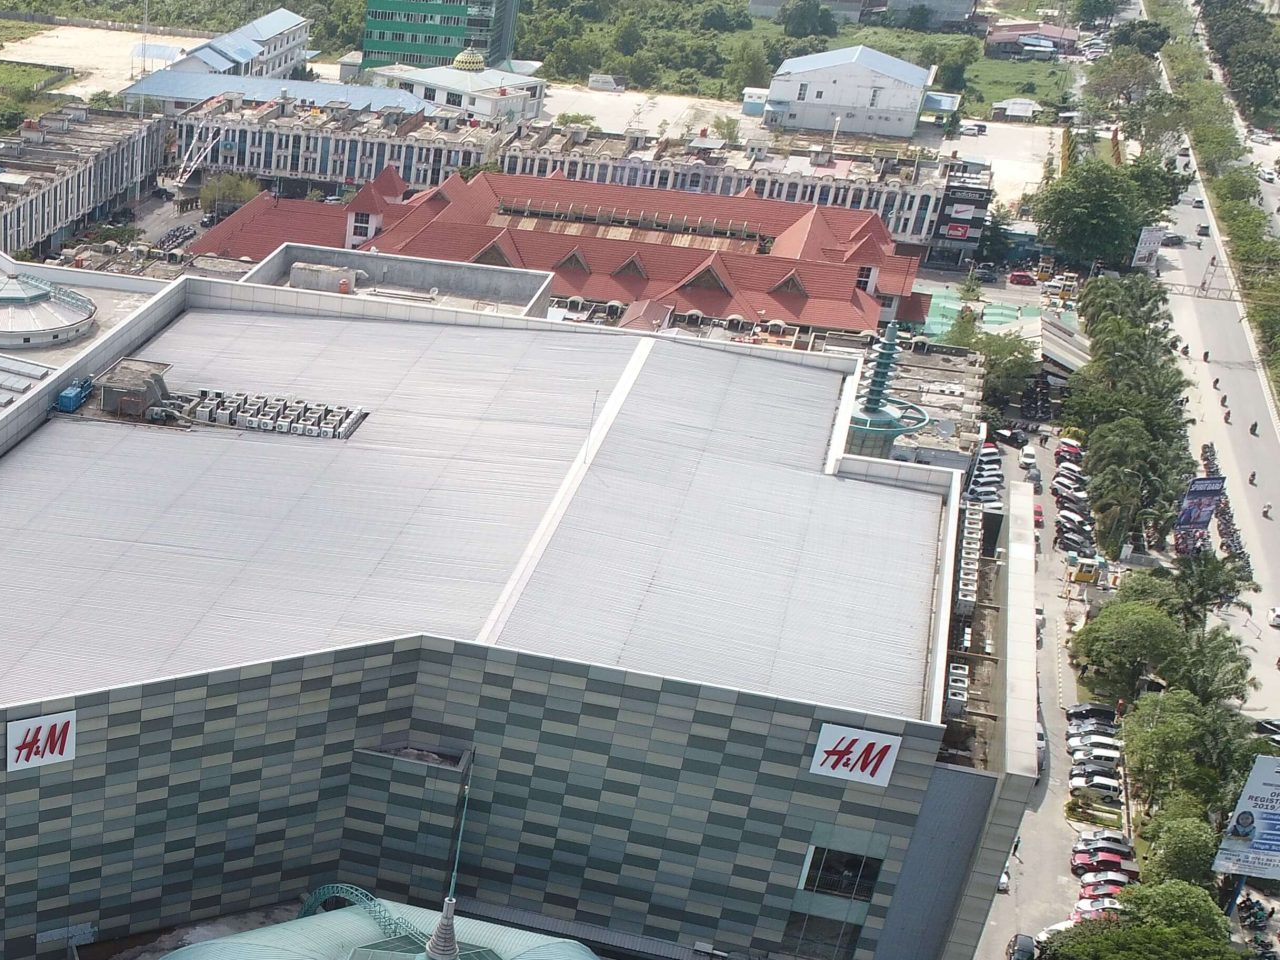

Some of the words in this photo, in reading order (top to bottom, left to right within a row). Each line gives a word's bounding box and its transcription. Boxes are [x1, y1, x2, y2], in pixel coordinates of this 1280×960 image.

[14, 719, 71, 764] H&M
[819, 736, 892, 778] H&M
[1248, 794, 1280, 805] REGIST
